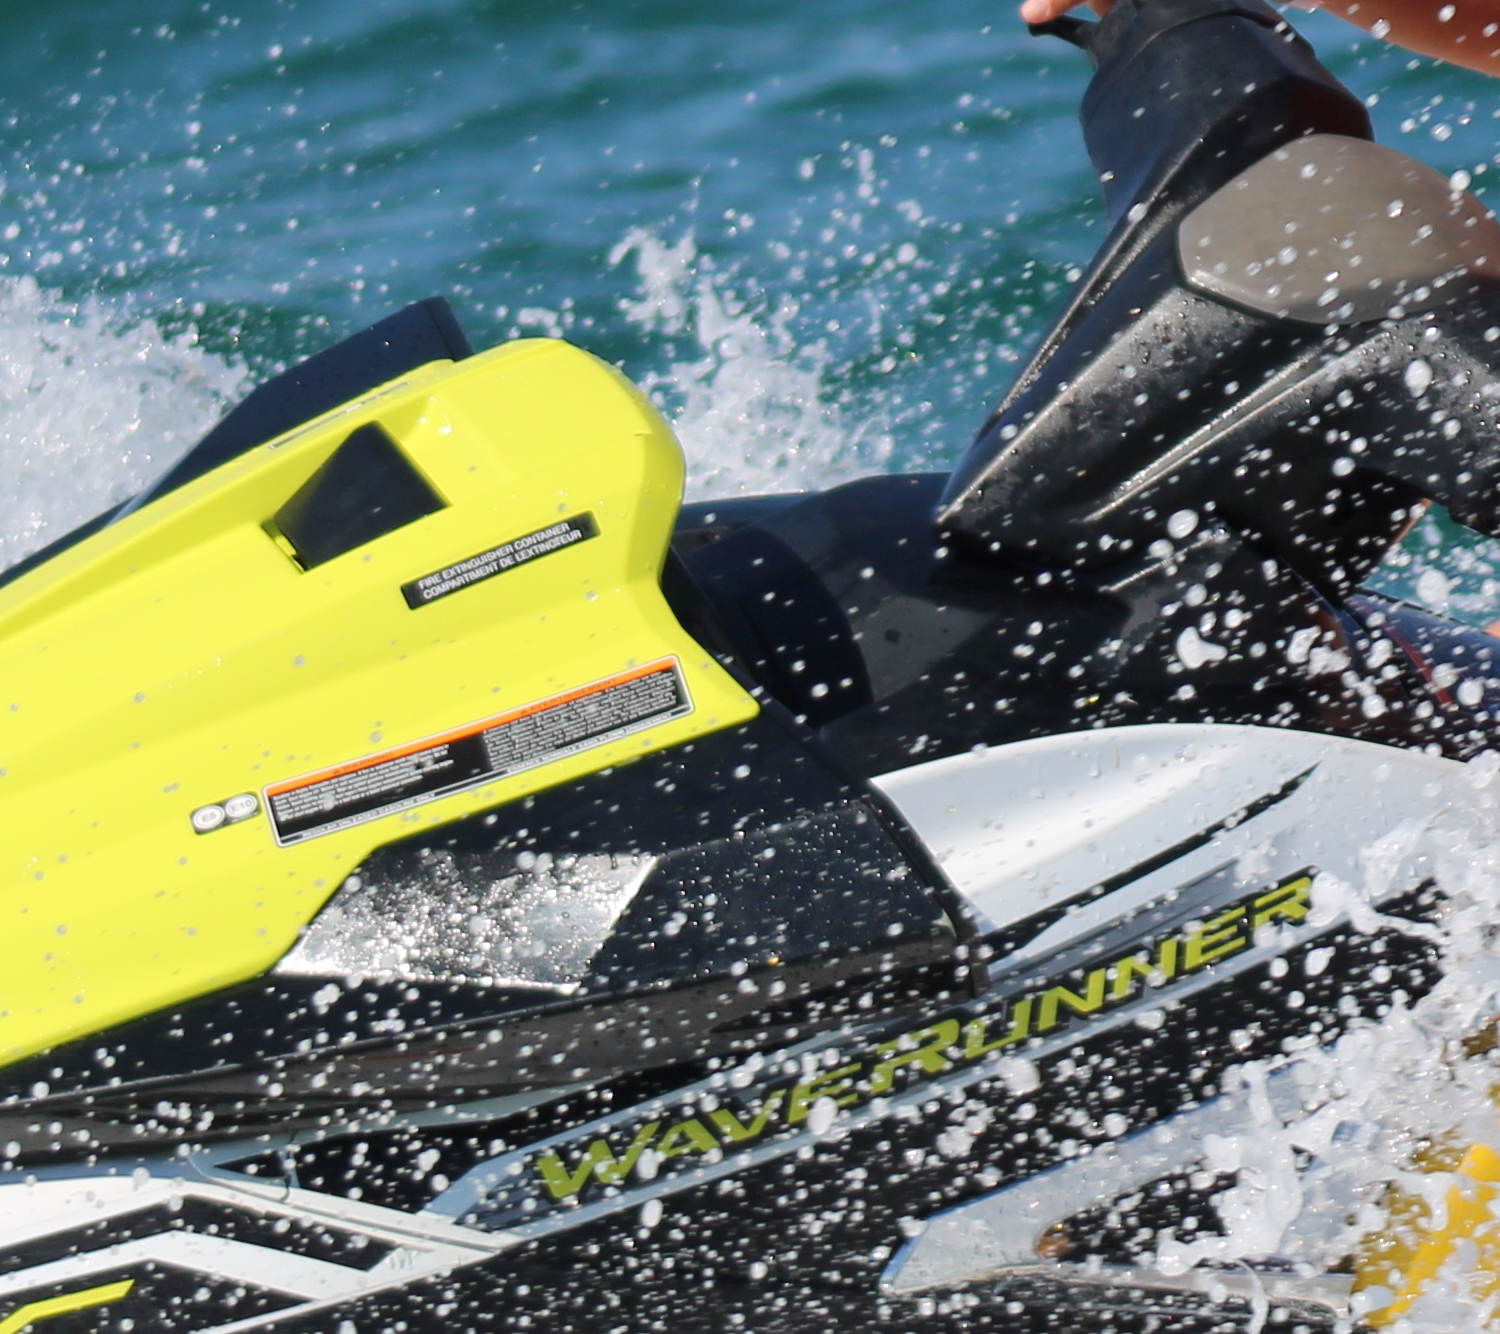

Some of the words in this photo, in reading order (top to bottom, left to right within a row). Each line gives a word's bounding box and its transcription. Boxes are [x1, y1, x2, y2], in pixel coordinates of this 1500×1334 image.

[418, 573, 442, 589] FIRE
[441, 544, 514, 580] EXTINGUISHER
[514, 522, 570, 550] CONTAINER
[423, 561, 498, 599] COMPARTIMENT
[499, 555, 515, 568] DE
